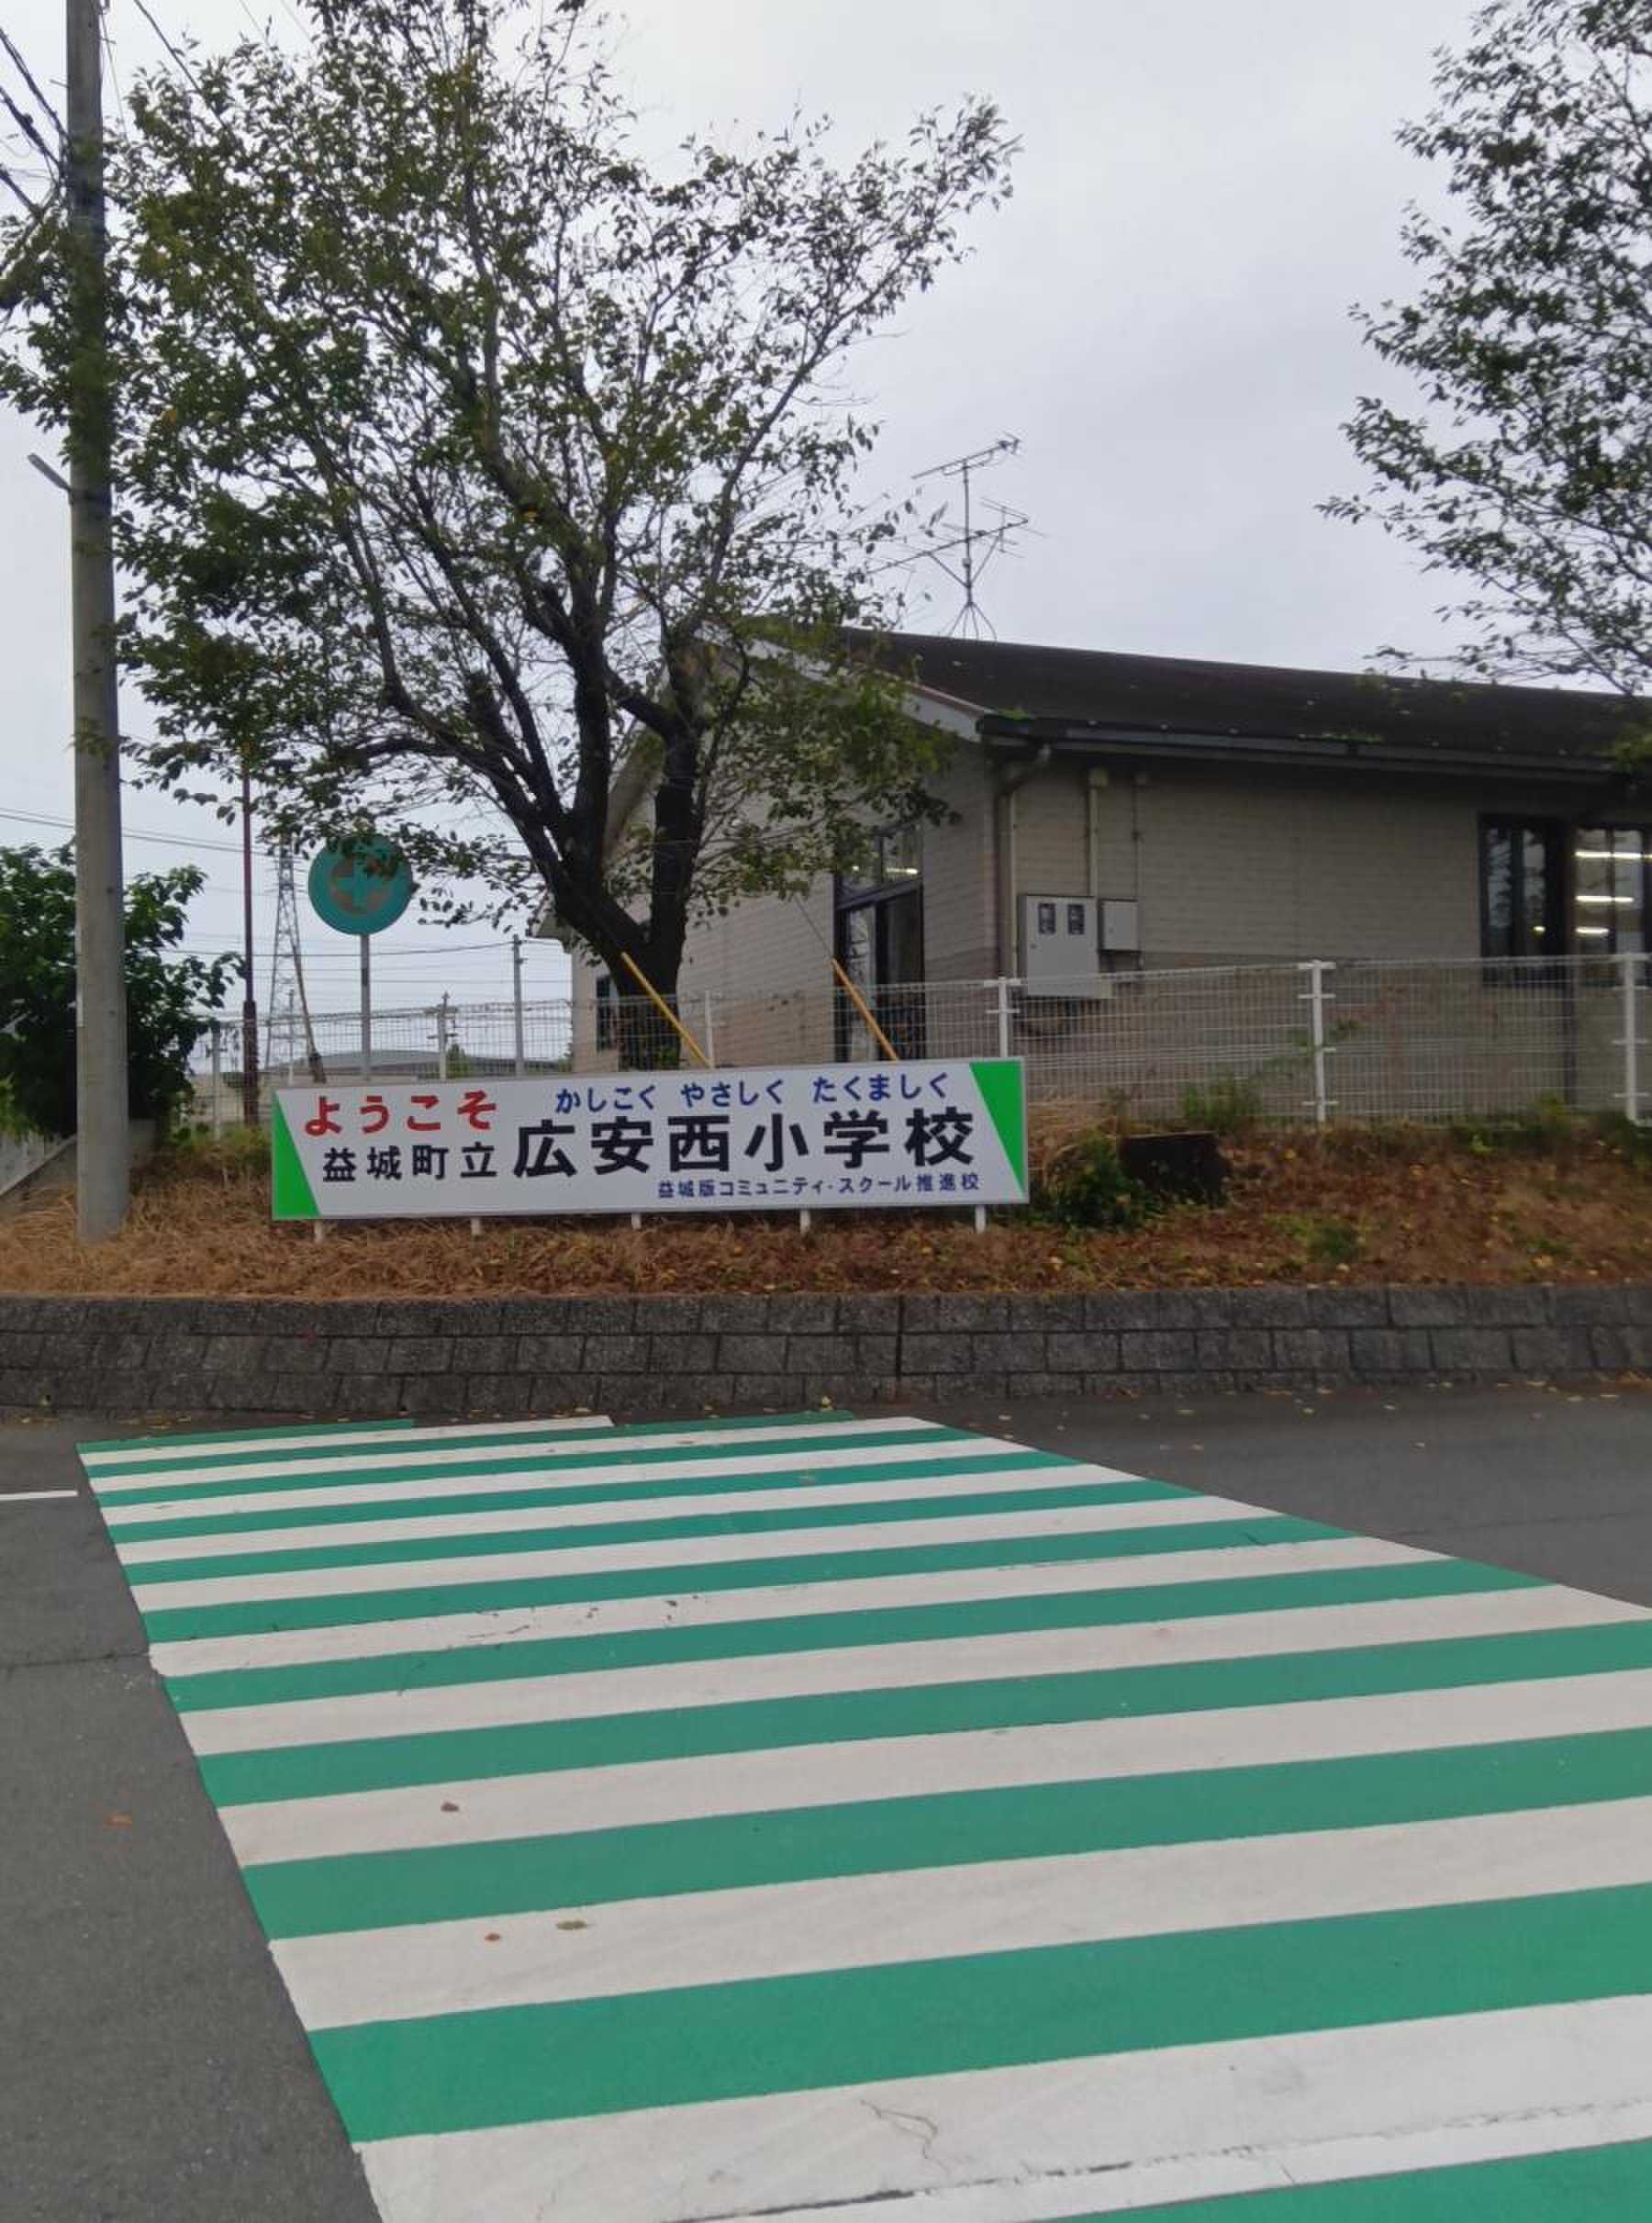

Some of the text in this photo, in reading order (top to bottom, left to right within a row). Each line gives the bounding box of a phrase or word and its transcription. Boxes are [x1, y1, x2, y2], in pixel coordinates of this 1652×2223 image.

[305, 1090, 497, 1136] ようこそ
[555, 1072, 948, 1114] かしこく やさしく たくましく
[323, 1105, 975, 1182] 益城町立 広安西小学校
